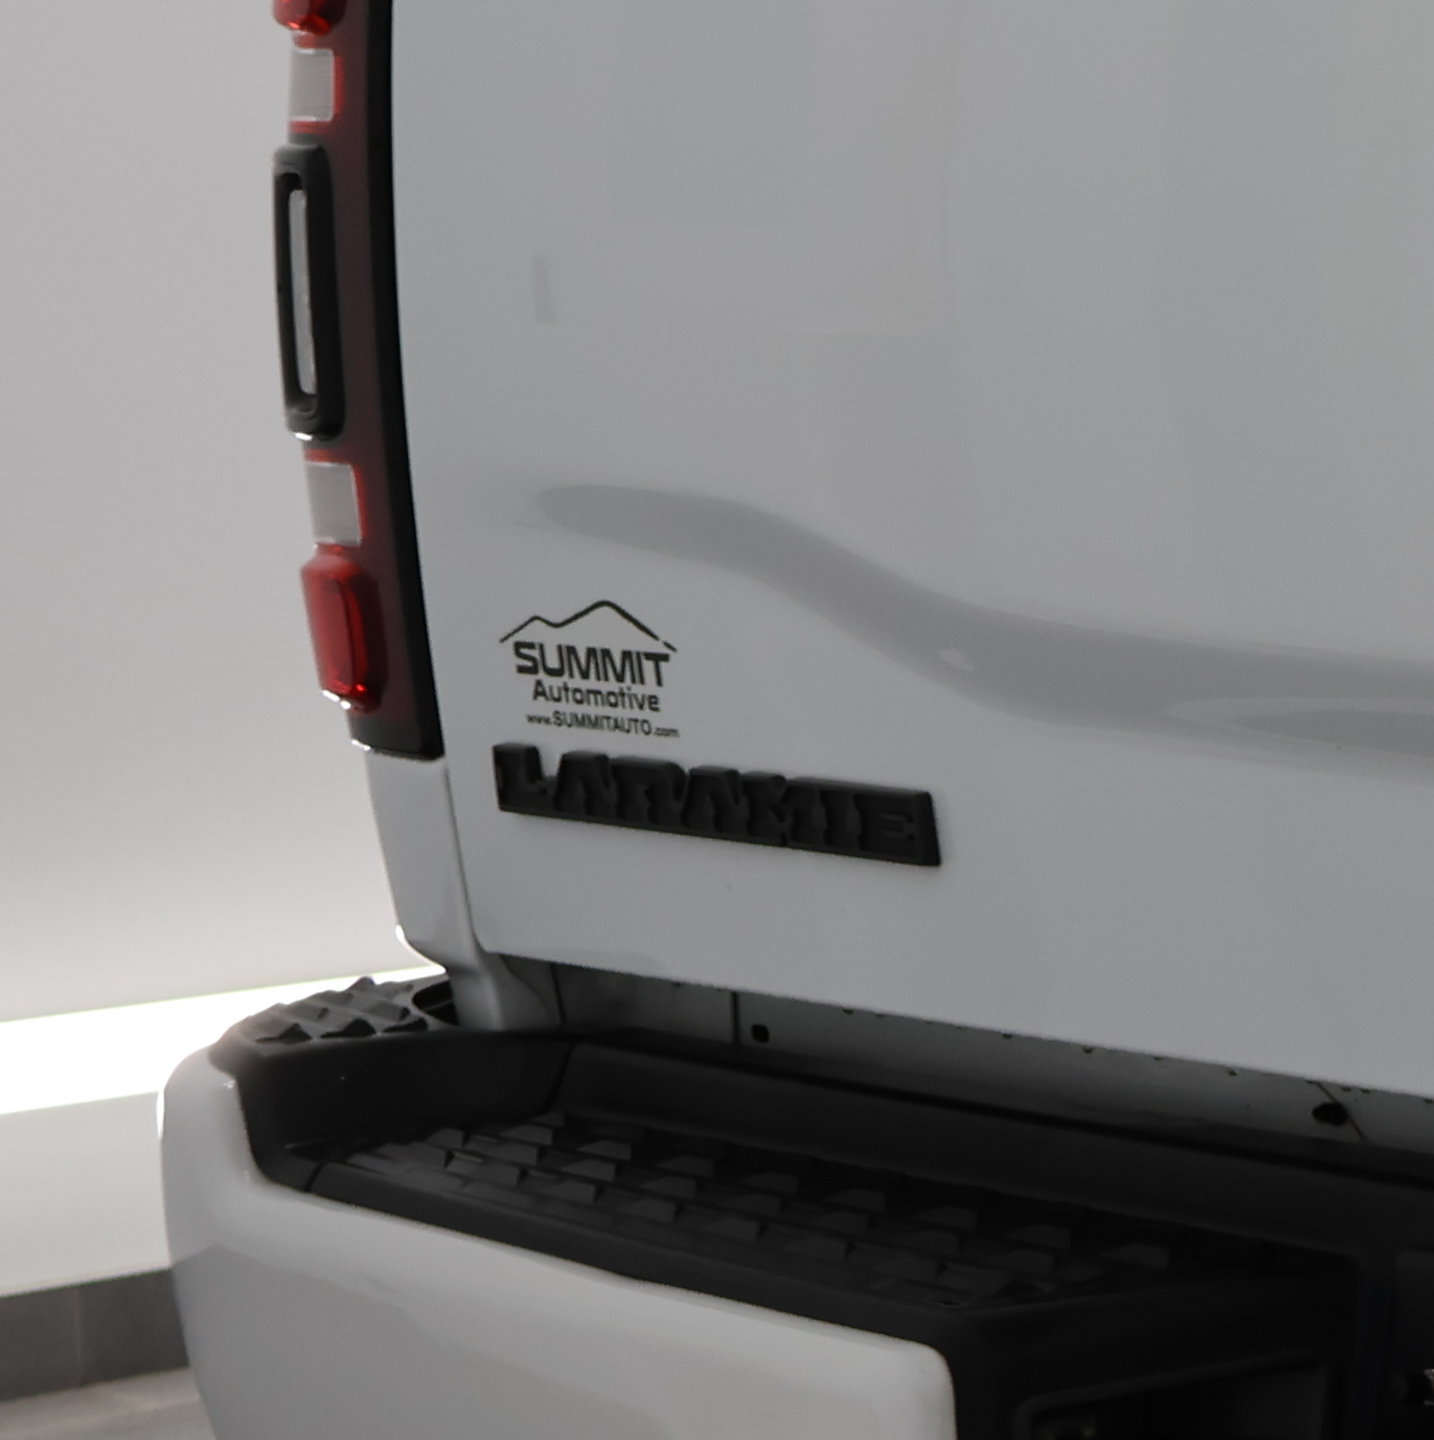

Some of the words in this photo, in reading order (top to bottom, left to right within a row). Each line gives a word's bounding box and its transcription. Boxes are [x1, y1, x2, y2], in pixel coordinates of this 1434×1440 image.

[513, 640, 670, 687] SUMMIT
[532, 679, 661, 712] Automotive
[526, 710, 680, 738] www.SUMMITAUTO.com
[492, 742, 942, 867] LARAMIE
